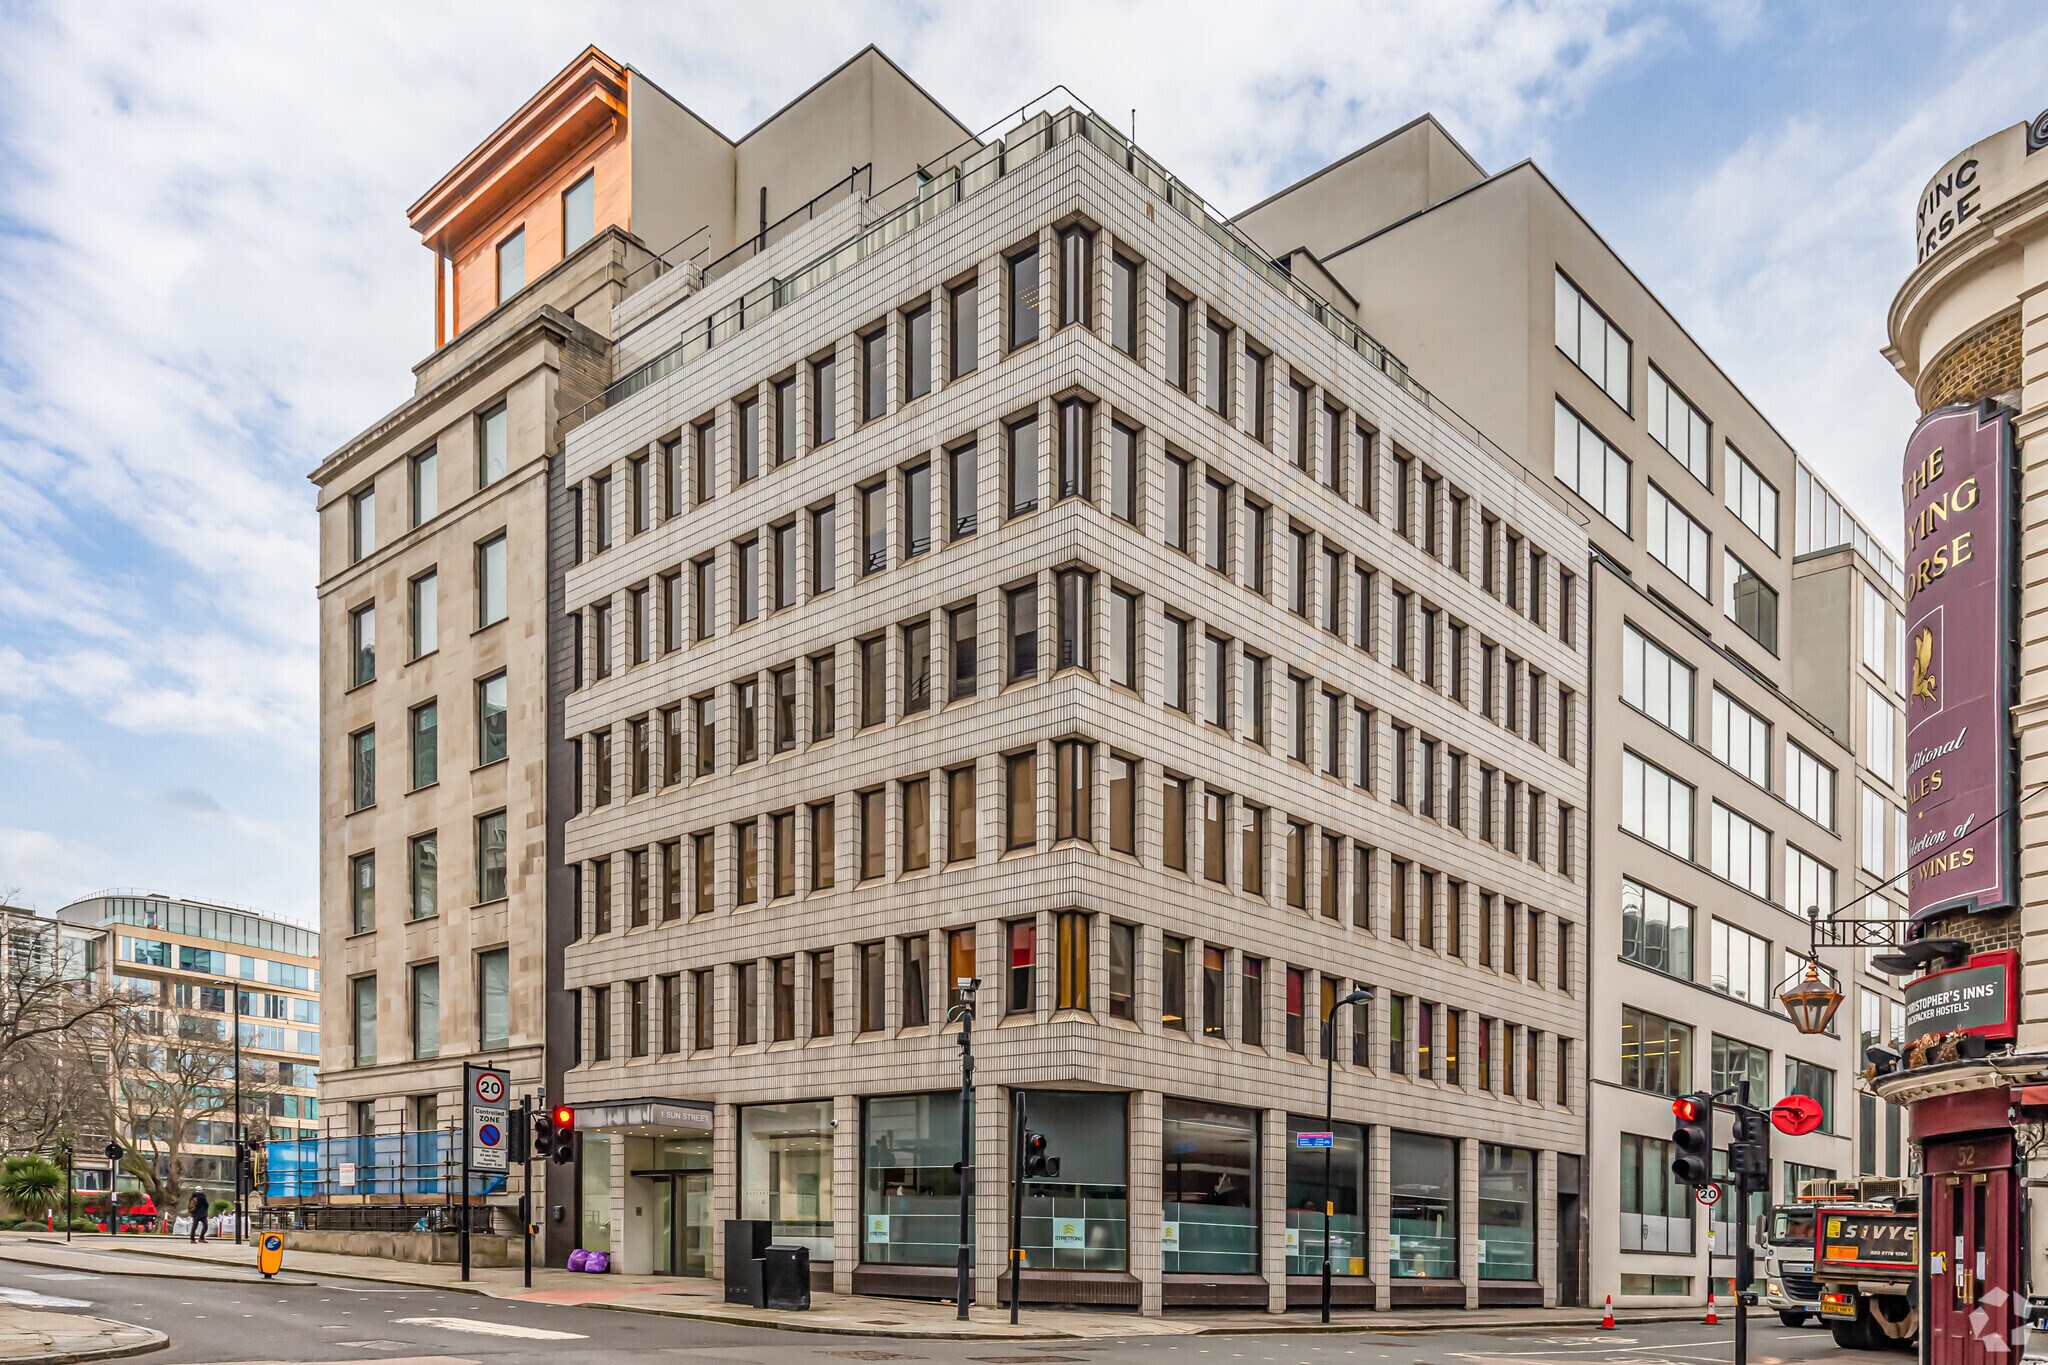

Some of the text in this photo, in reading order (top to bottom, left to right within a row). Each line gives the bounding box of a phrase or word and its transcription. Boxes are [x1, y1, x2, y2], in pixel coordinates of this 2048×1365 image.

[1917, 159, 1979, 243] YING
[1904, 445, 1944, 508] THE
[1909, 769, 1942, 806] ALES
[1953, 812, 1976, 839] of
[1919, 847, 1975, 881] WINES
[1963, 984, 1994, 1000] INNS
[1936, 1001, 1970, 1017] HOSTELS
[481, 1081, 500, 1094] 20
[475, 1108, 505, 1116] Controlled
[479, 1115, 500, 1123] ZONE
[666, 1111, 681, 1119] SUN
[682, 1113, 709, 1122] STREET
[1958, 1146, 1975, 1166] 52
[1700, 1189, 1717, 1199] 20
